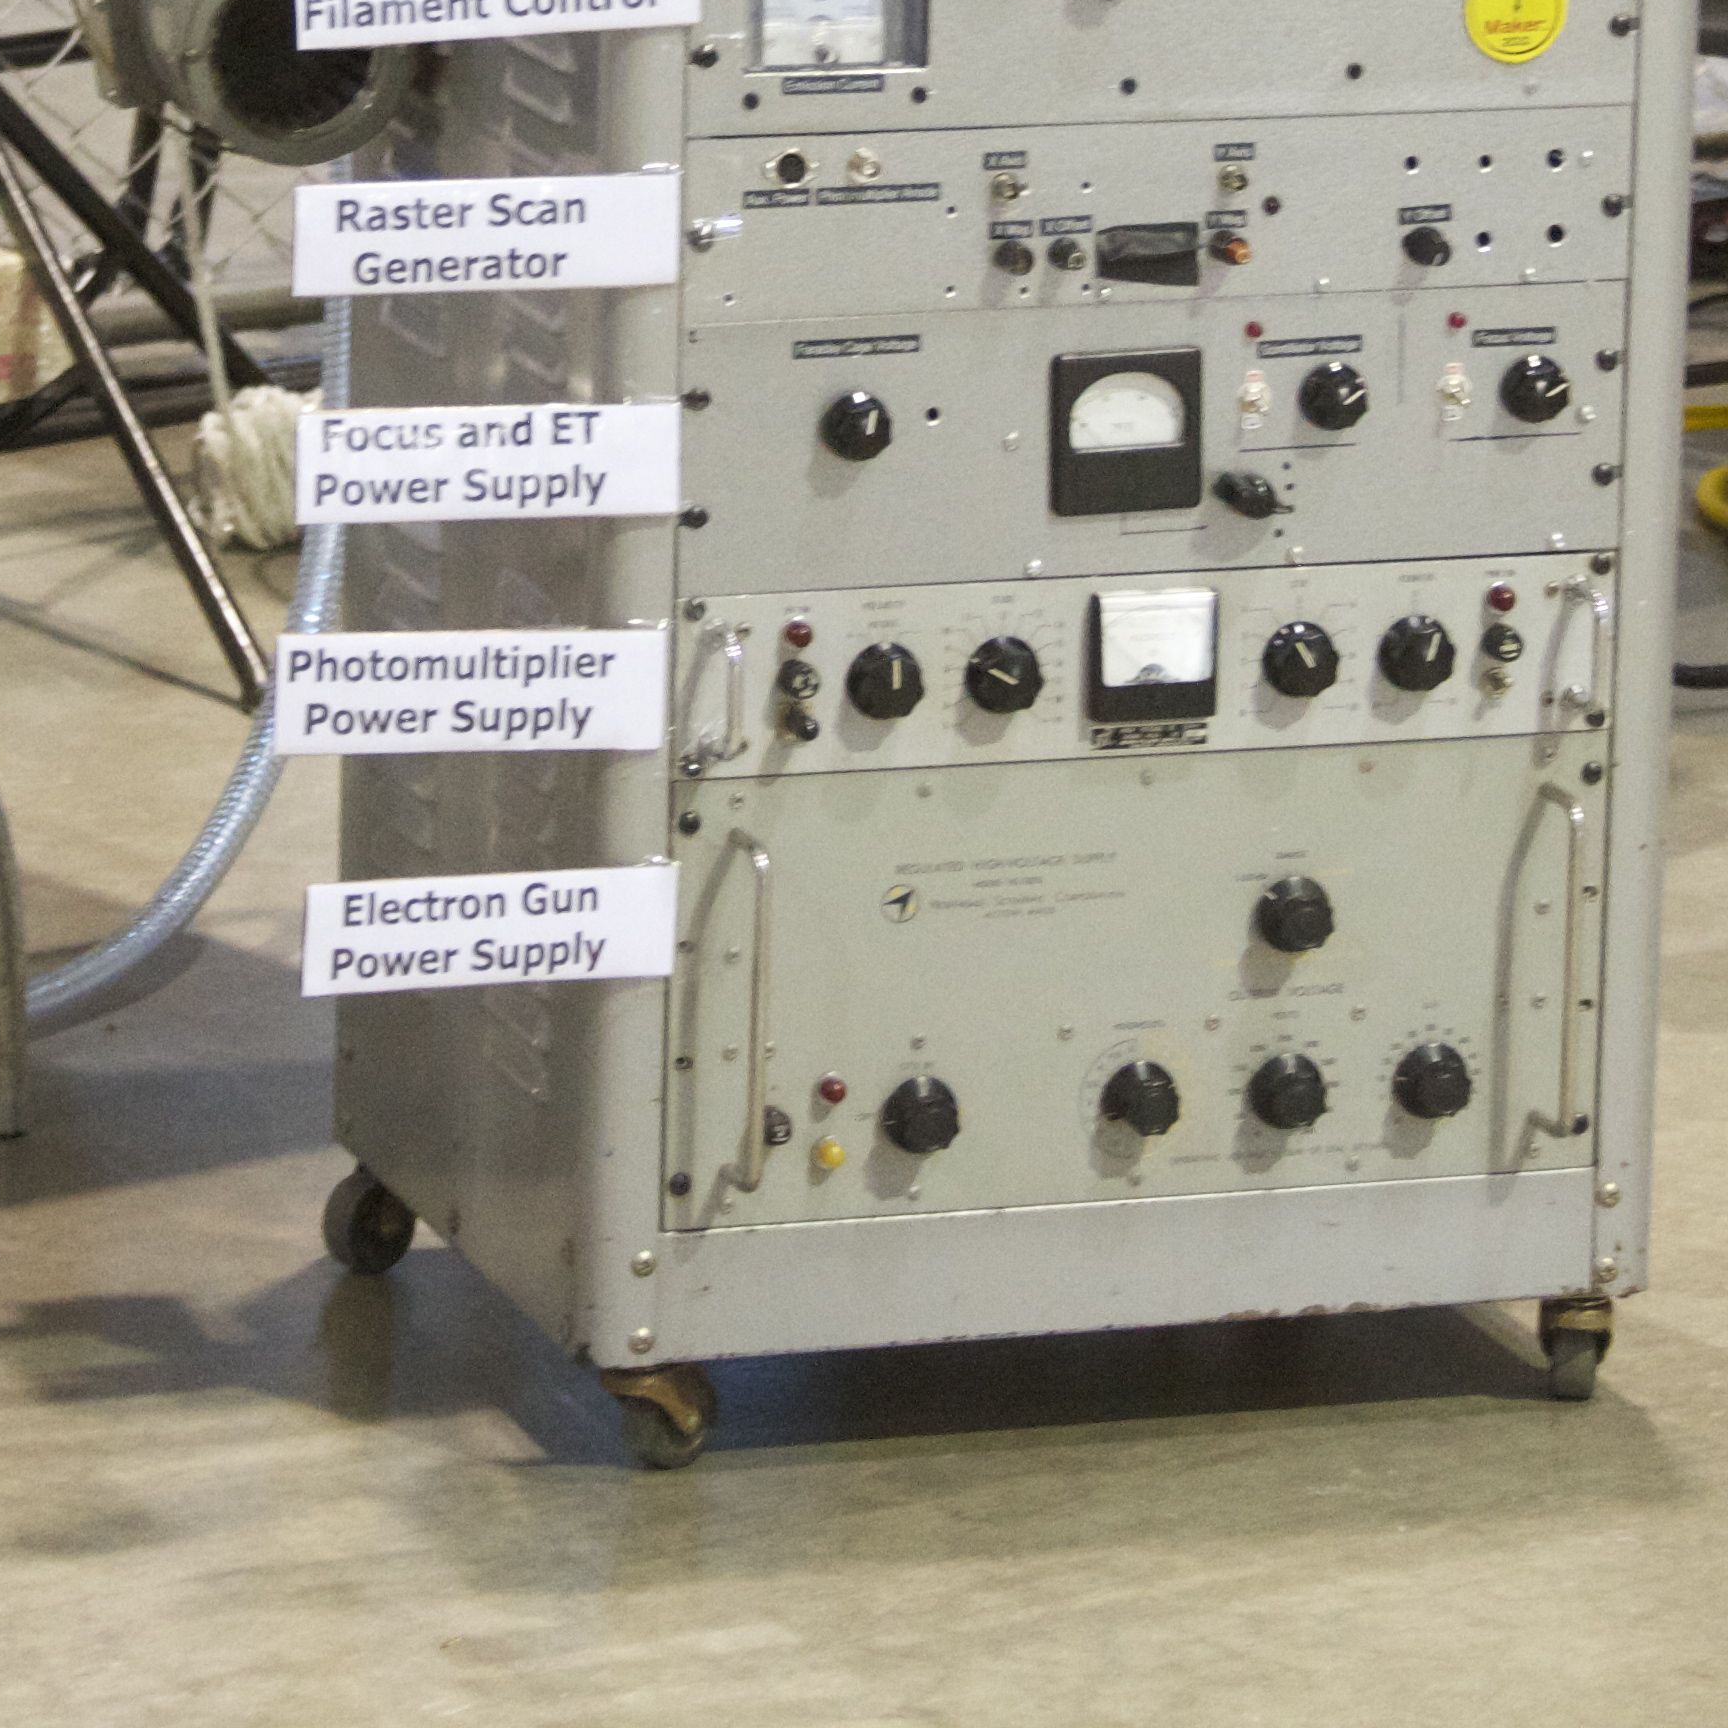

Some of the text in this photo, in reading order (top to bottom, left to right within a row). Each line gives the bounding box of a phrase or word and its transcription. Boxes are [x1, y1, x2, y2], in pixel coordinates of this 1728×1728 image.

[337, 194, 584, 231] Raster Scan
[354, 249, 567, 285] Generator
[324, 412, 600, 451] Focus and ET
[316, 465, 606, 508] Power Supply
[289, 646, 615, 687] Photomultiplier
[305, 698, 591, 740] Power Supply
[344, 883, 597, 926] Electron Gun
[332, 932, 605, 979] Power Supply
